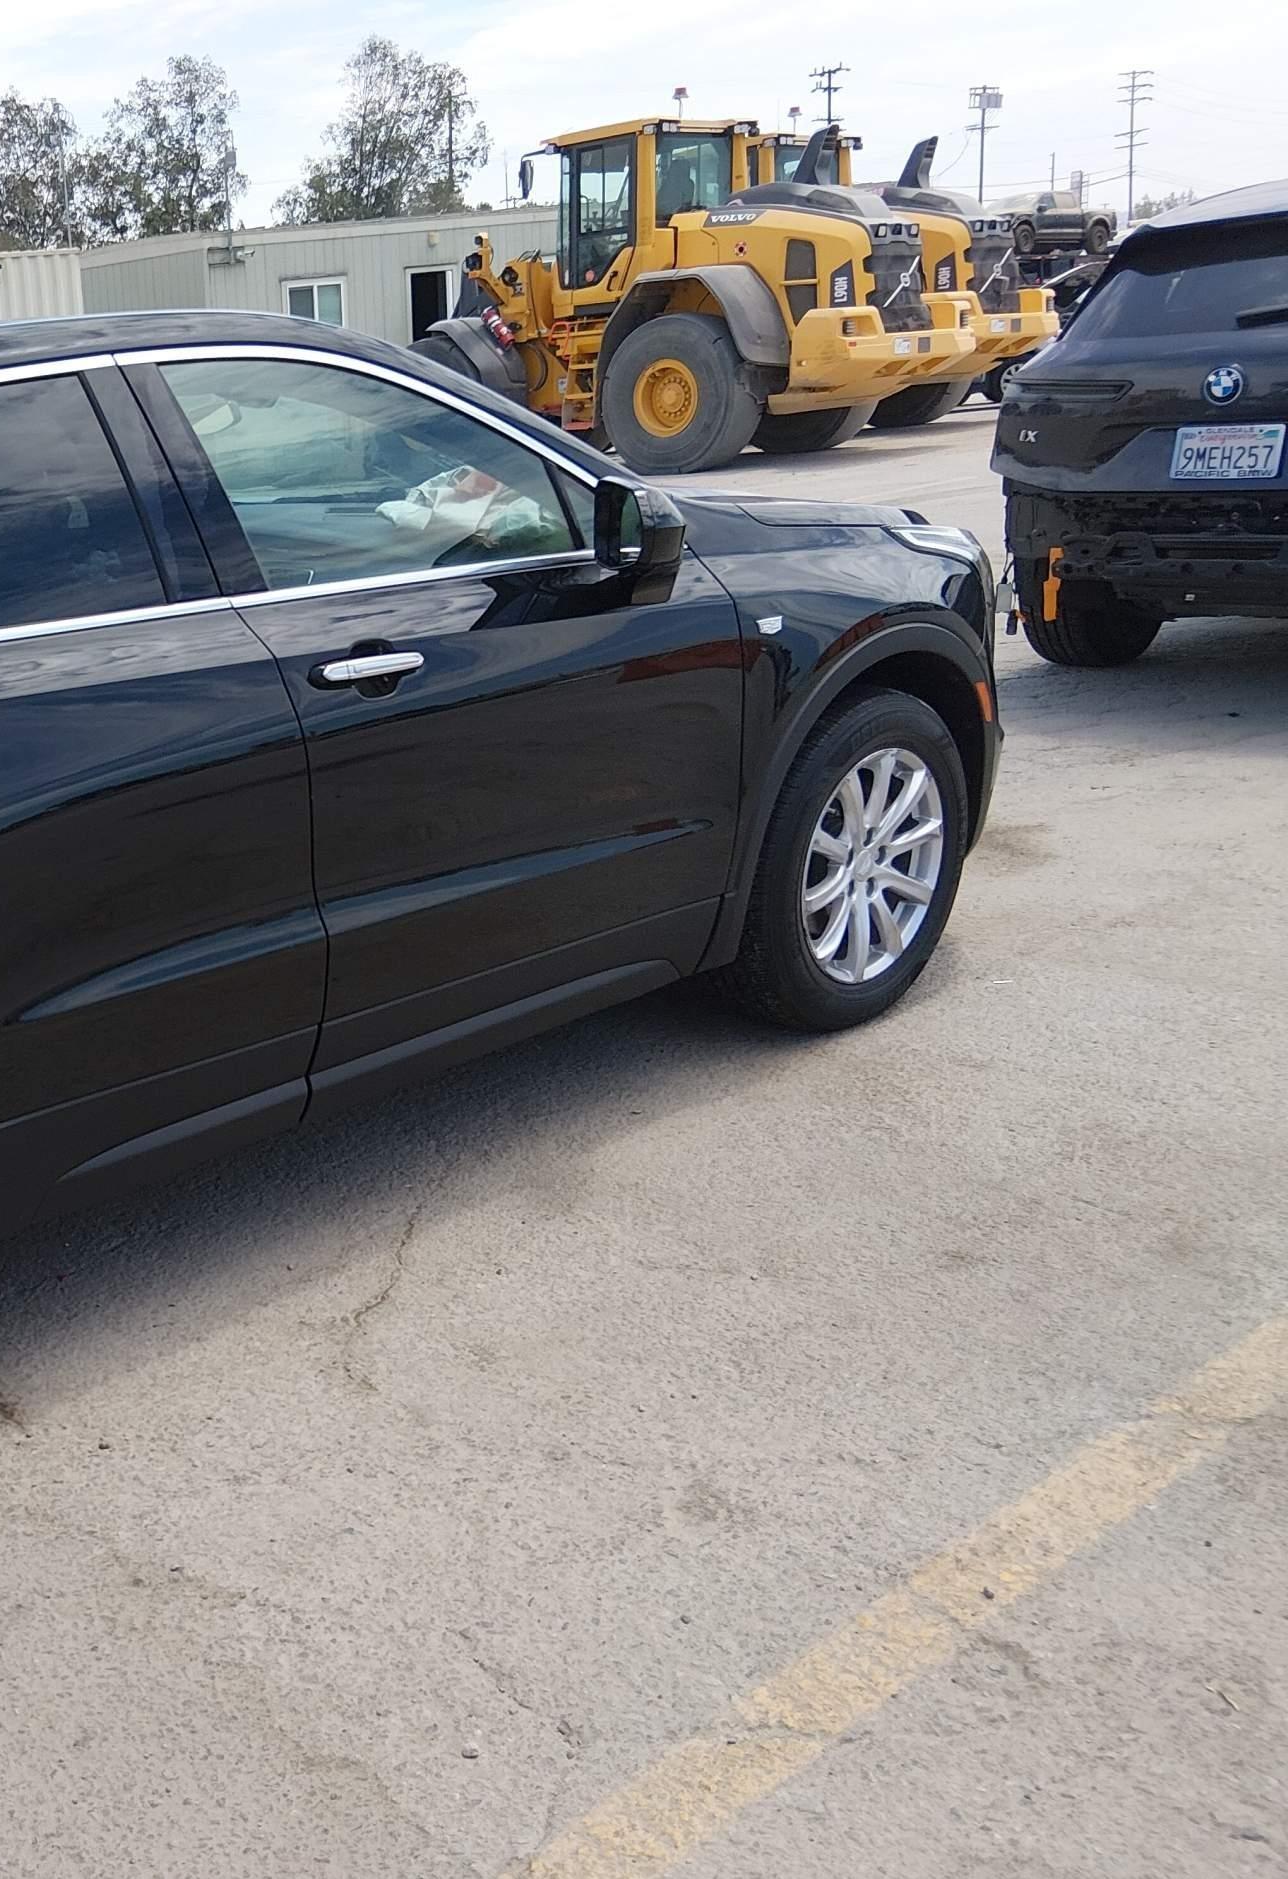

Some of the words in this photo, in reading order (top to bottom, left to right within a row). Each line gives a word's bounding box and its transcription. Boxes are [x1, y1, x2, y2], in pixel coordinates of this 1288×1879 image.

[710, 213, 757, 223] VOLVO
[834, 276, 849, 302] L90H
[1180, 444, 1274, 470] 9MEH257
[1174, 470, 1231, 478] PACIFIC
[1237, 469, 1274, 477] BMW
